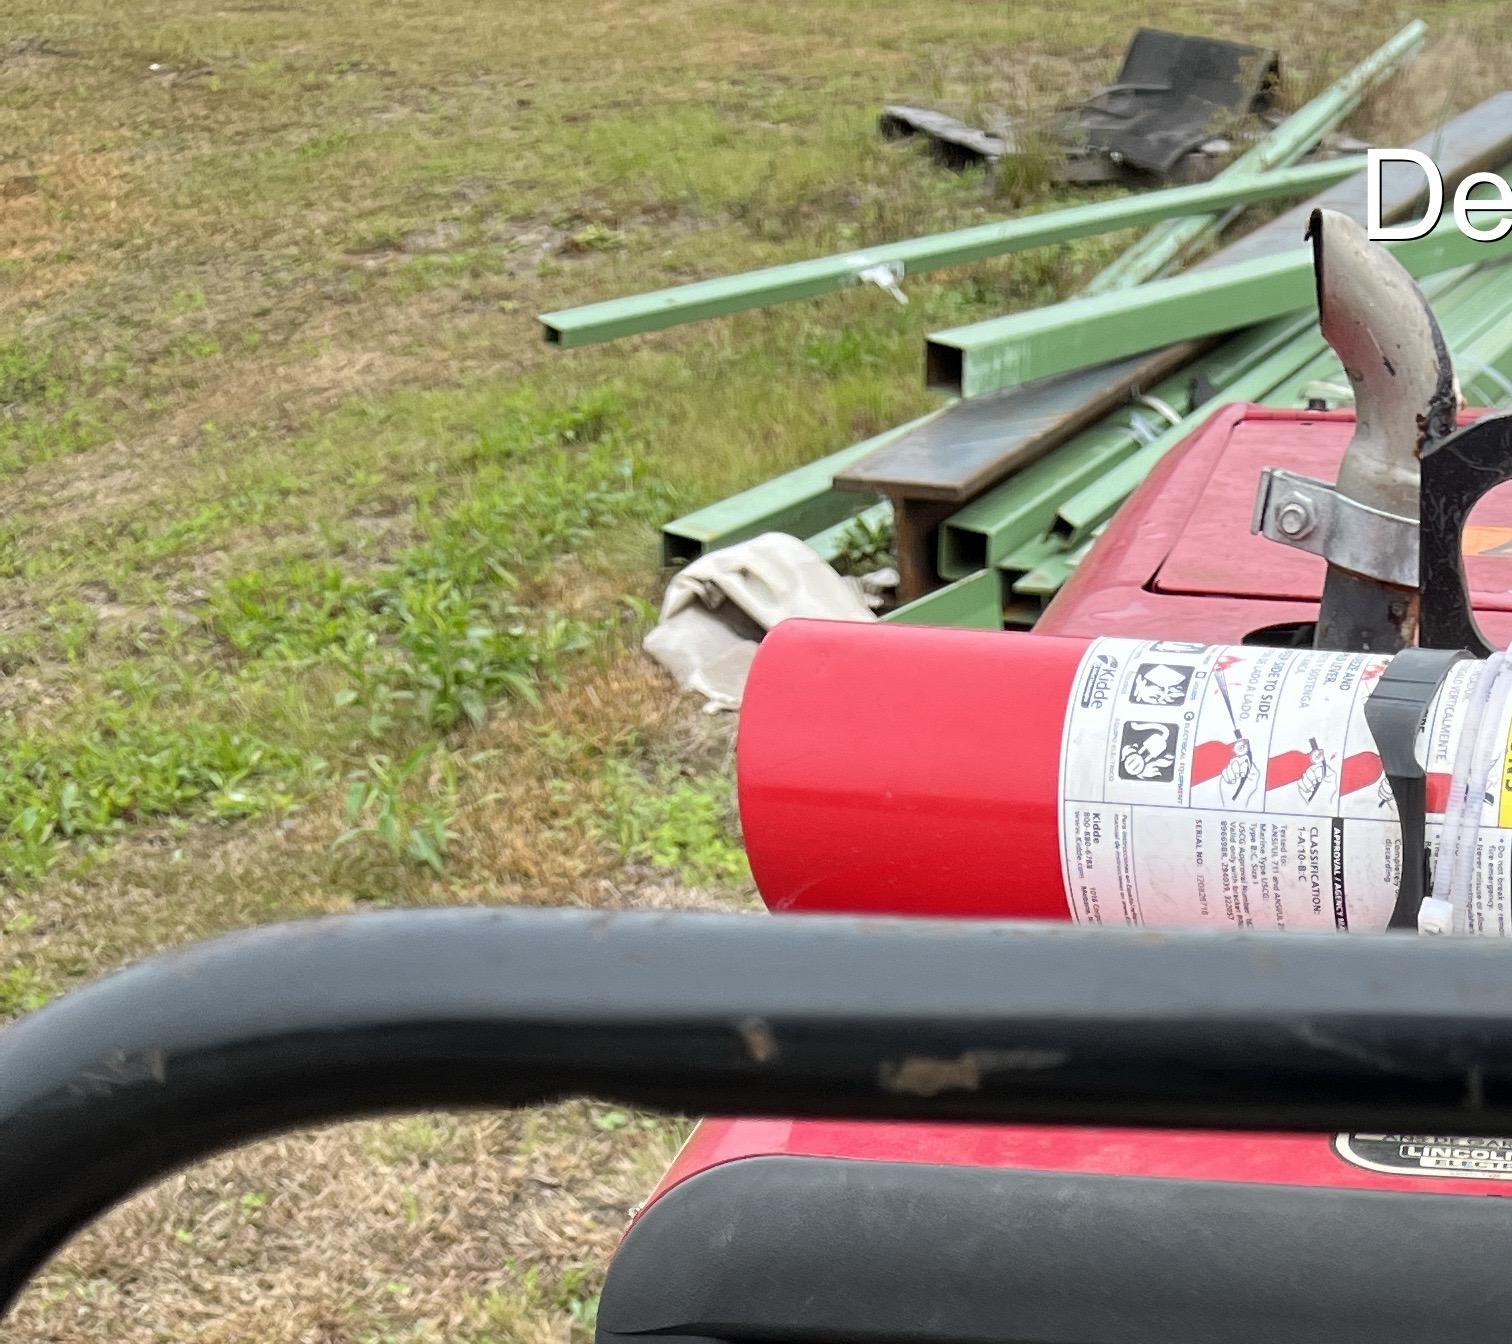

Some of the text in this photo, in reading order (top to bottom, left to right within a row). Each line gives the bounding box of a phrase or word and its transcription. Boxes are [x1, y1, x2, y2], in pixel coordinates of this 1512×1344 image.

[1091, 669, 1117, 709] Kidde
[1263, 680, 1279, 691] TO
[1339, 672, 1355, 691] AND
[1255, 694, 1272, 723] SIDE.
[1092, 813, 1101, 844] Kidde
[1333, 828, 1342, 876] APPROVAL
[1309, 827, 1321, 915] CLASSIFICATION:
[1334, 884, 1344, 916] AGENCY
